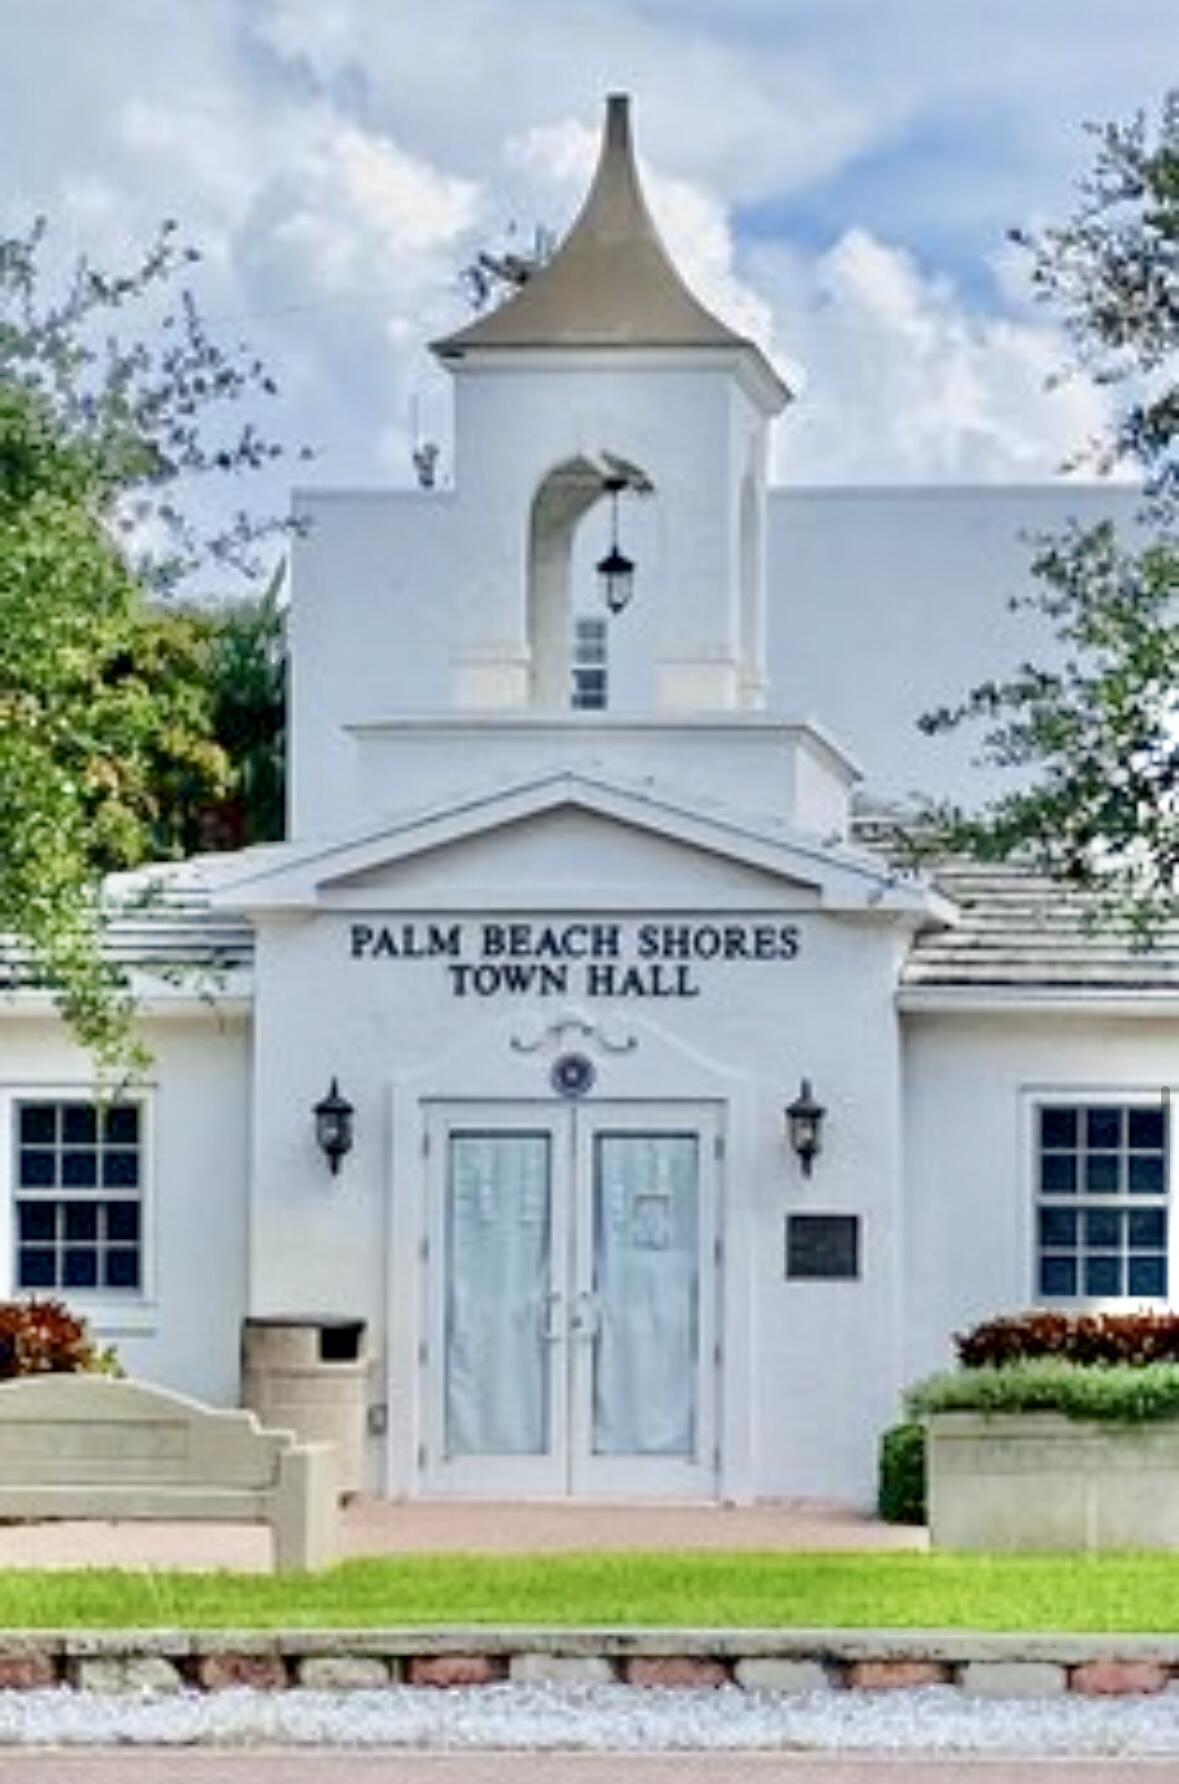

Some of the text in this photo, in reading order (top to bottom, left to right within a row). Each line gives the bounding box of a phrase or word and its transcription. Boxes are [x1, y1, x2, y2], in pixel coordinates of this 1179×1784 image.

[350, 924, 800, 960] PALM BEACH SHORES
[448, 964, 699, 997] TOWN HALL
